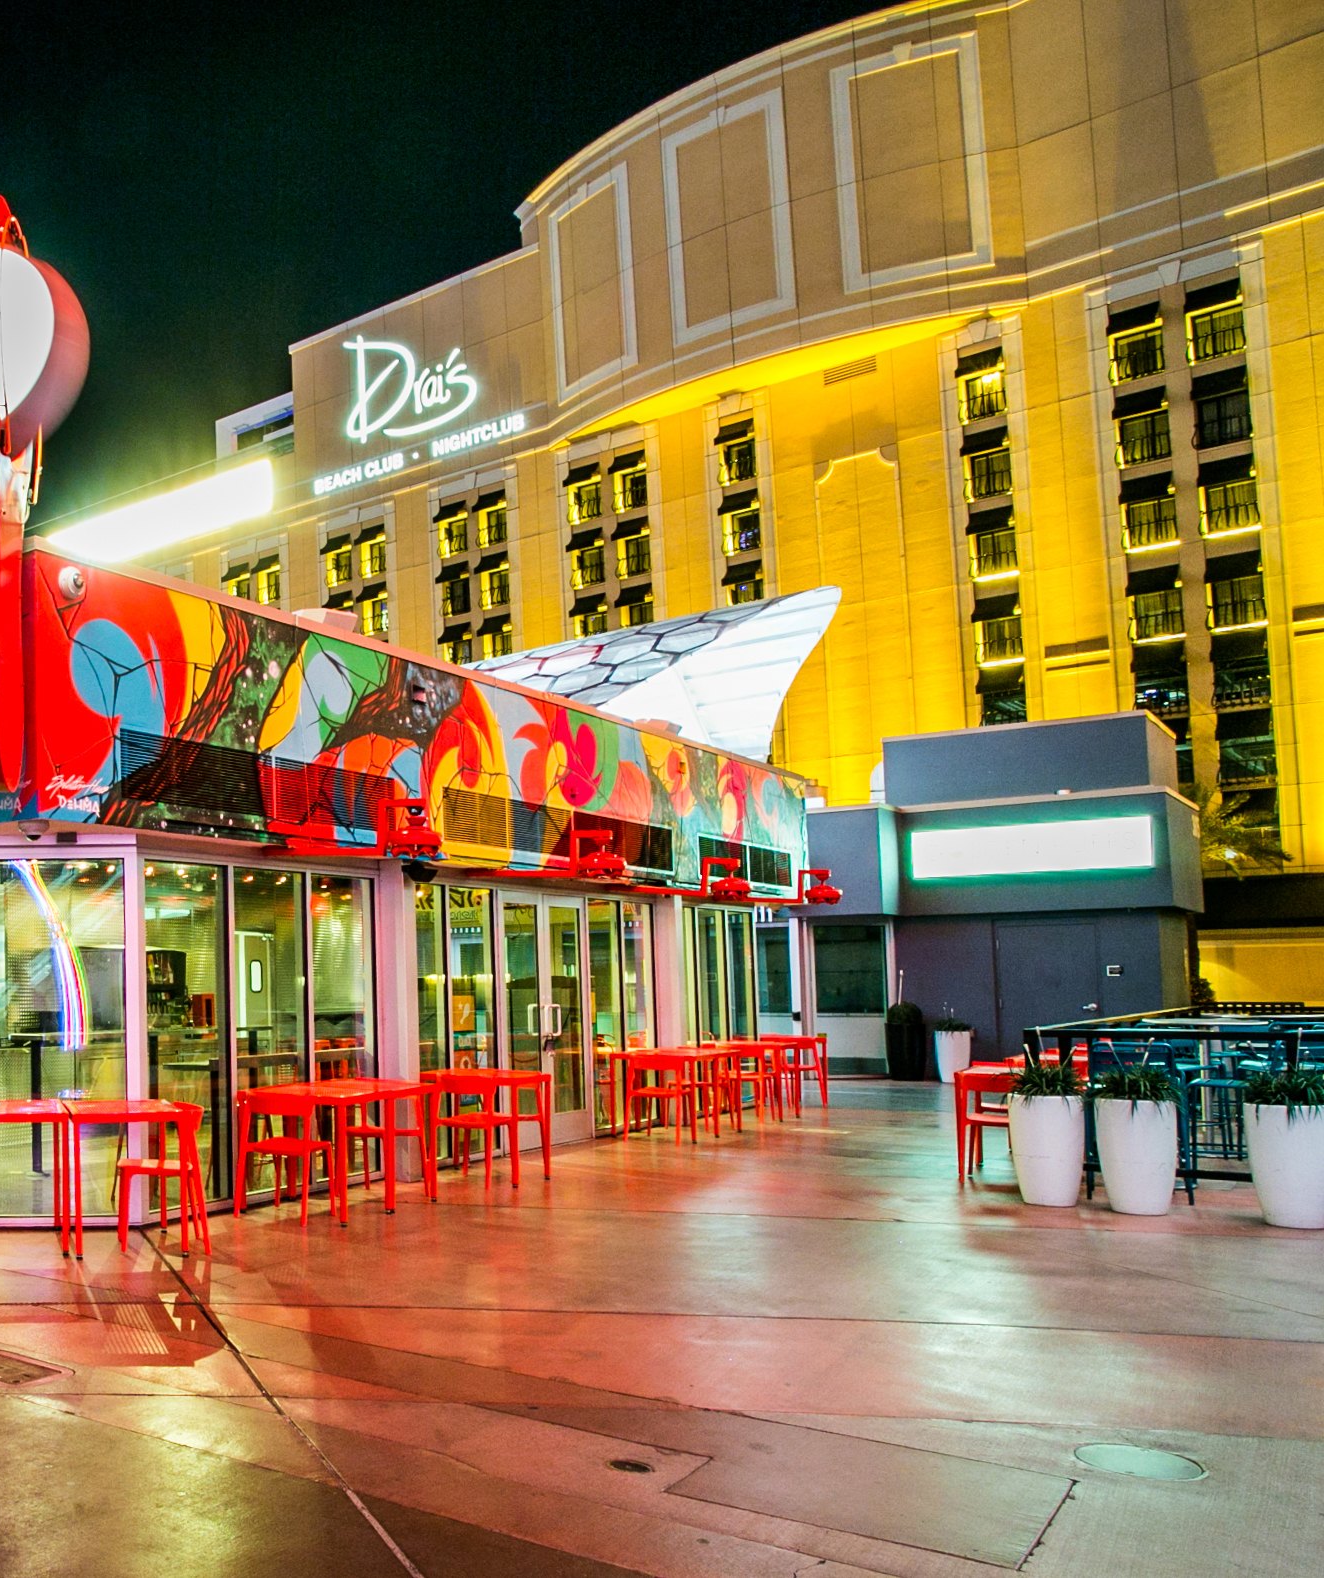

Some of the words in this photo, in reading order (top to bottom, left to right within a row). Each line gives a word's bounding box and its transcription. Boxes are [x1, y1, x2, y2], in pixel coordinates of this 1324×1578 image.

[342, 334, 478, 444] Drai's
[313, 467, 362, 496] BEACH
[363, 452, 404, 479] CLUB
[431, 413, 526, 458] NIGHTCLUB
